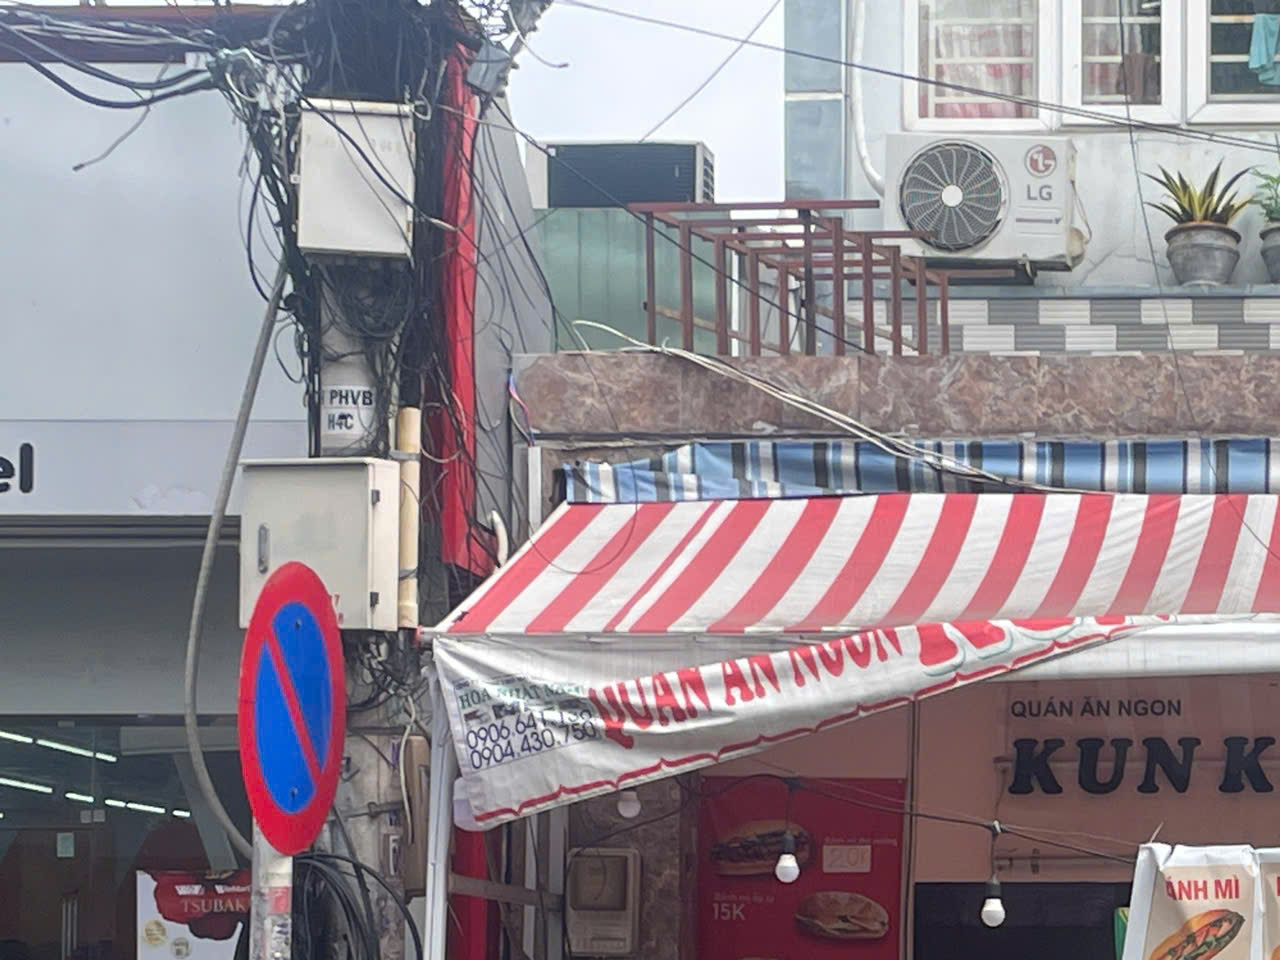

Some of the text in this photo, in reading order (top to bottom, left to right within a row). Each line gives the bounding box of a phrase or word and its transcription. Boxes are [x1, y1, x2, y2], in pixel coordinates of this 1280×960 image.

[1027, 184, 1053, 200] LG
[330, 389, 373, 405] PHVB
[1010, 698, 1071, 718] QUÁN
[1118, 700, 1182, 717] NGON
[471, 719, 597, 769] 0904.430.750
[1009, 737, 1200, 794] KUN
[1165, 874, 1240, 900] ÁNH MÌ
[182, 899, 246, 912] TSUBAK
[712, 903, 745, 920] 15K
